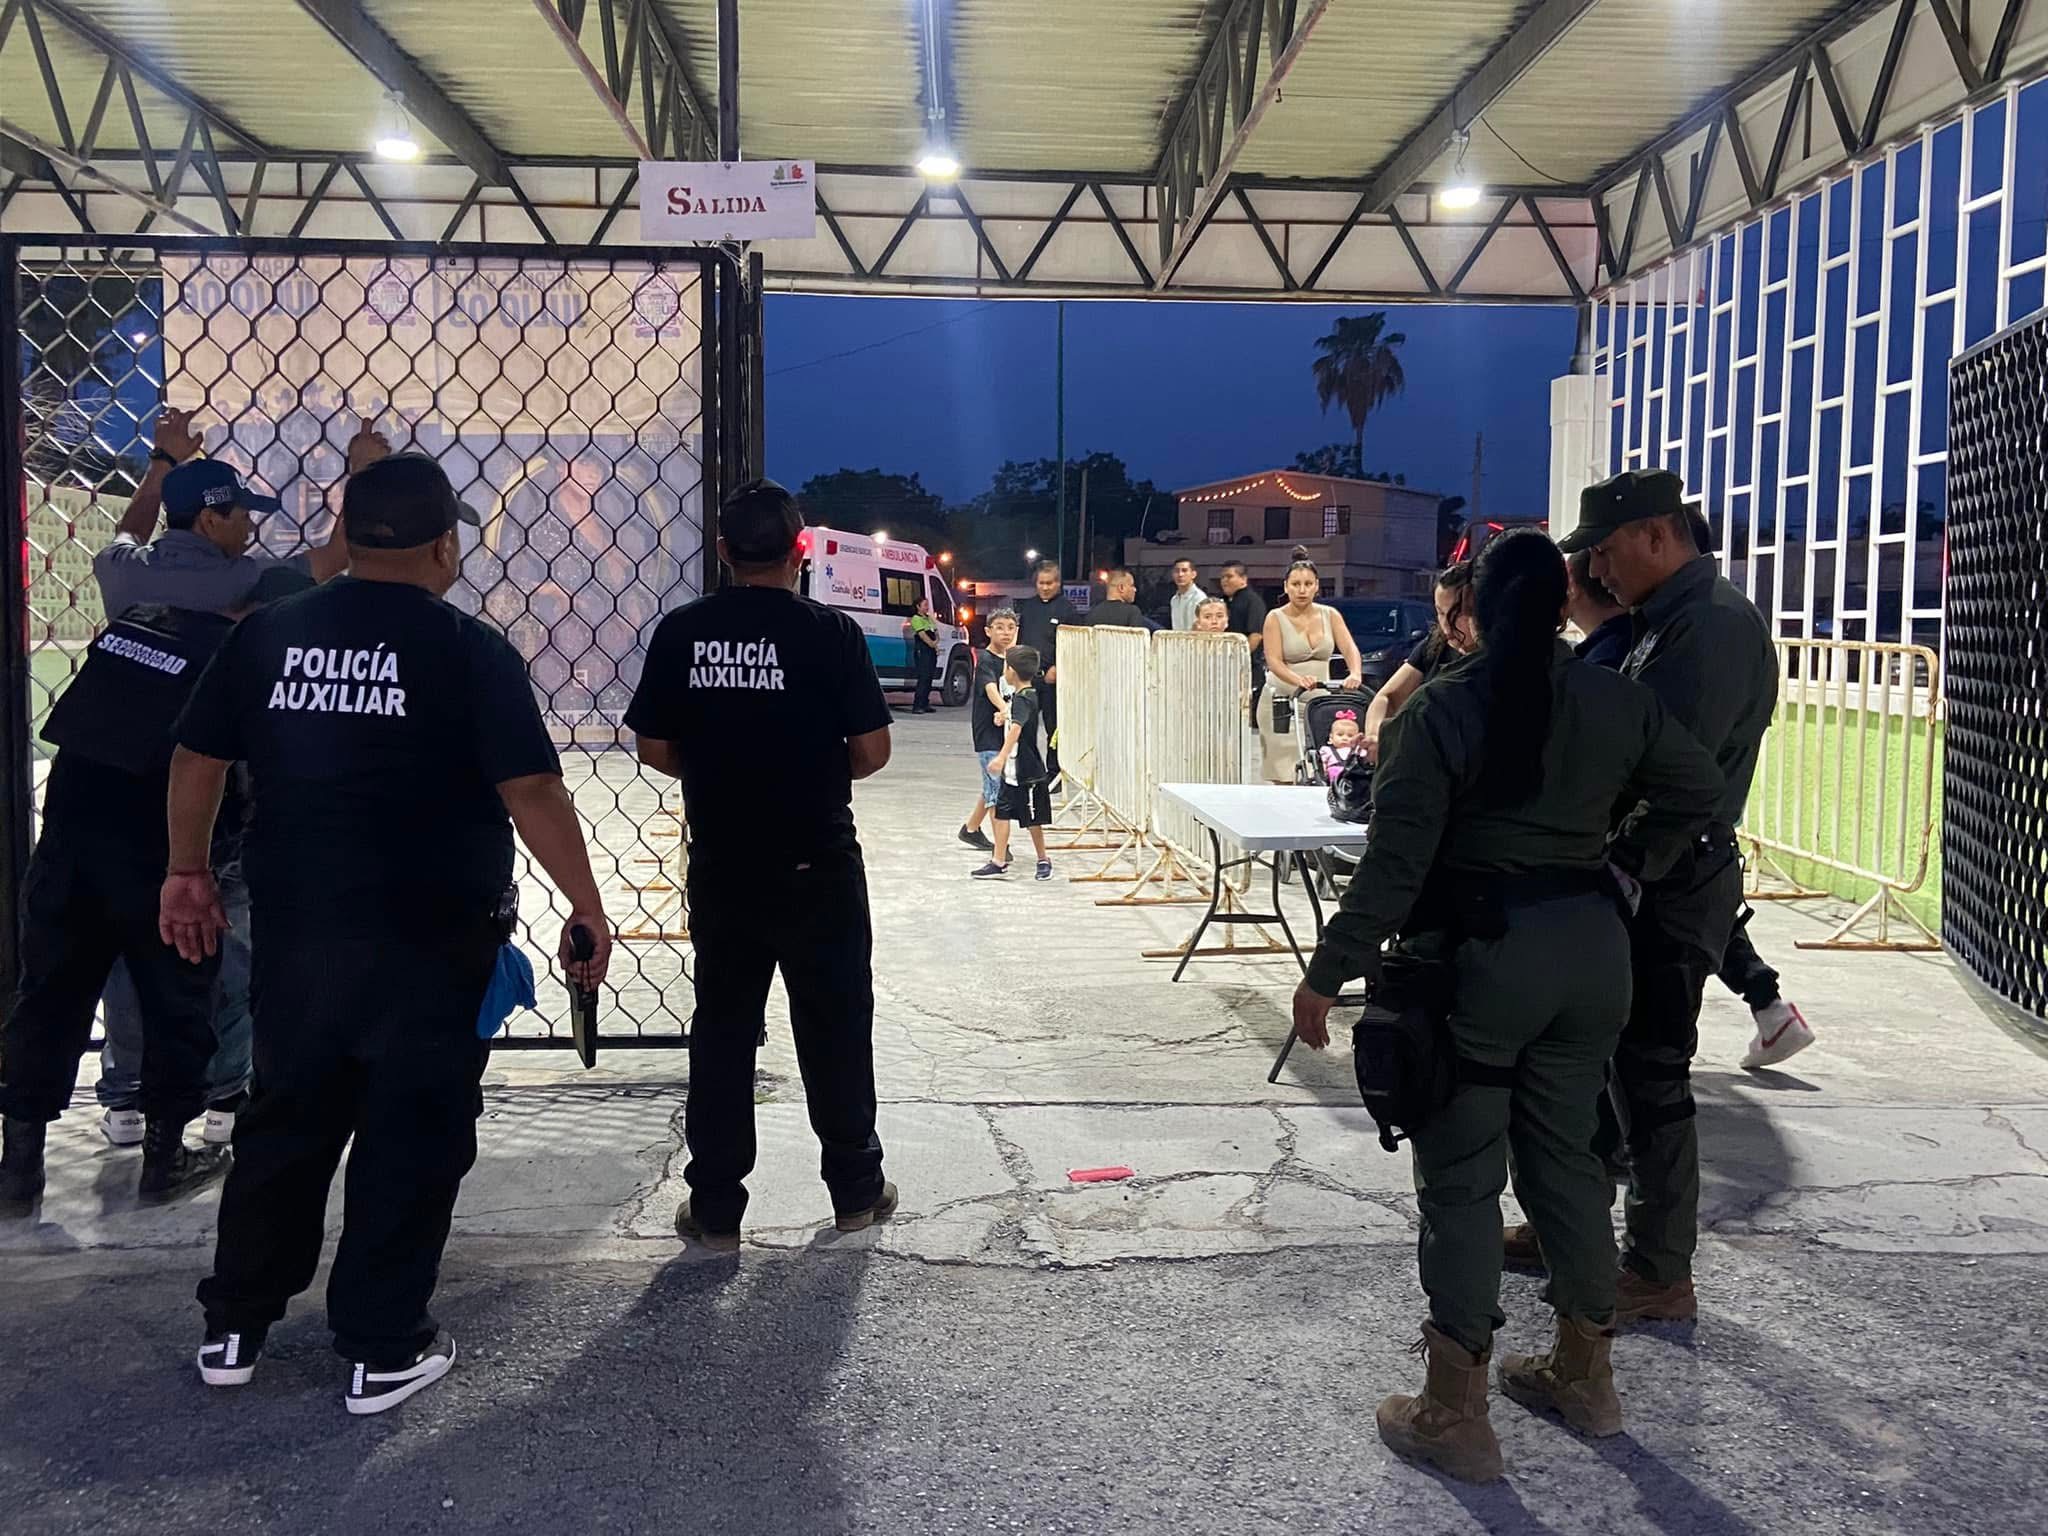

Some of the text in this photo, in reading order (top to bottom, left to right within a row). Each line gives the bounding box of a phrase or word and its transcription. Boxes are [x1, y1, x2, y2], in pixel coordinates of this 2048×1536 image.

[97, 633, 188, 675] SEGURIDAD
[283, 642, 399, 682] POLICÍA
[693, 637, 779, 667] POLICÍA
[689, 666, 785, 690] AUXILIAR
[268, 681, 407, 717] AUXILIAR
